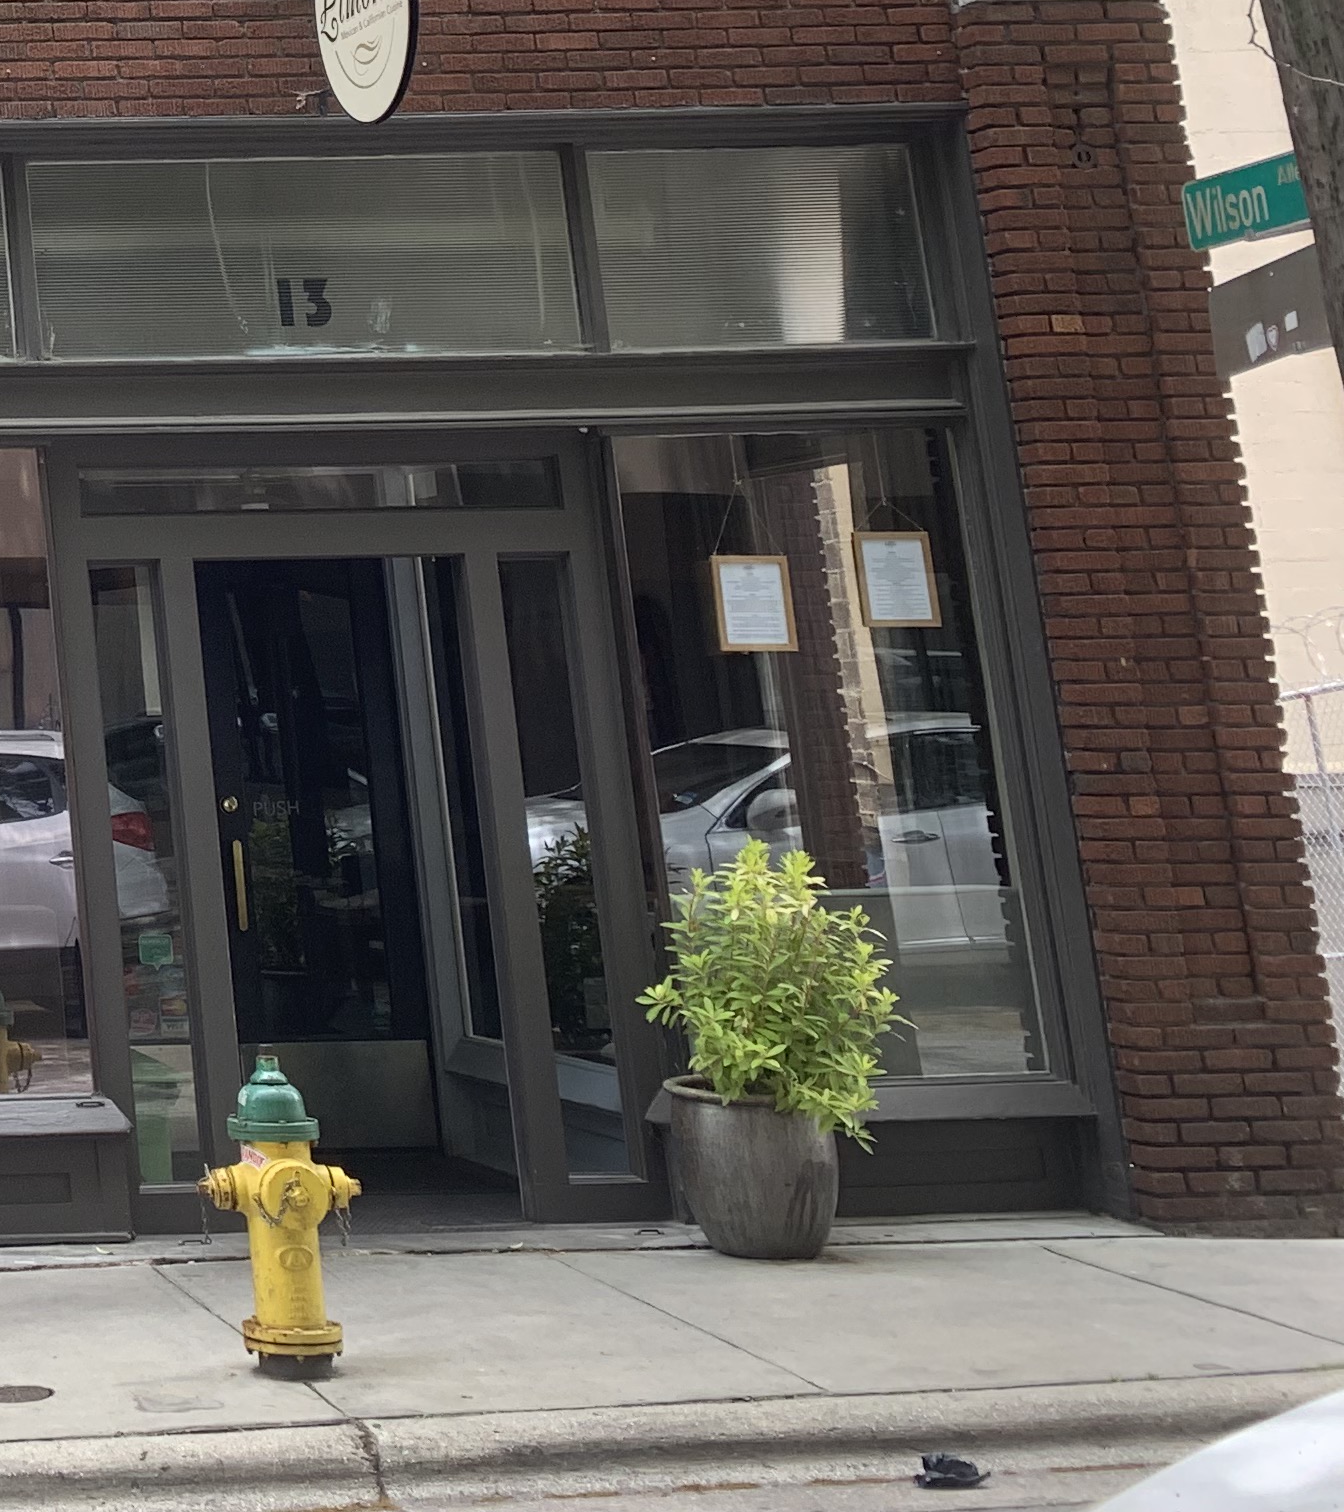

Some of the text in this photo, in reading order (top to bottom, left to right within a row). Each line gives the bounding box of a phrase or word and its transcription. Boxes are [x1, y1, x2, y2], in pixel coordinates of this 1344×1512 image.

[1186, 163, 1301, 240] Wilson Alle
[276, 277, 333, 328] 13
[253, 800, 300, 817] PUSH
